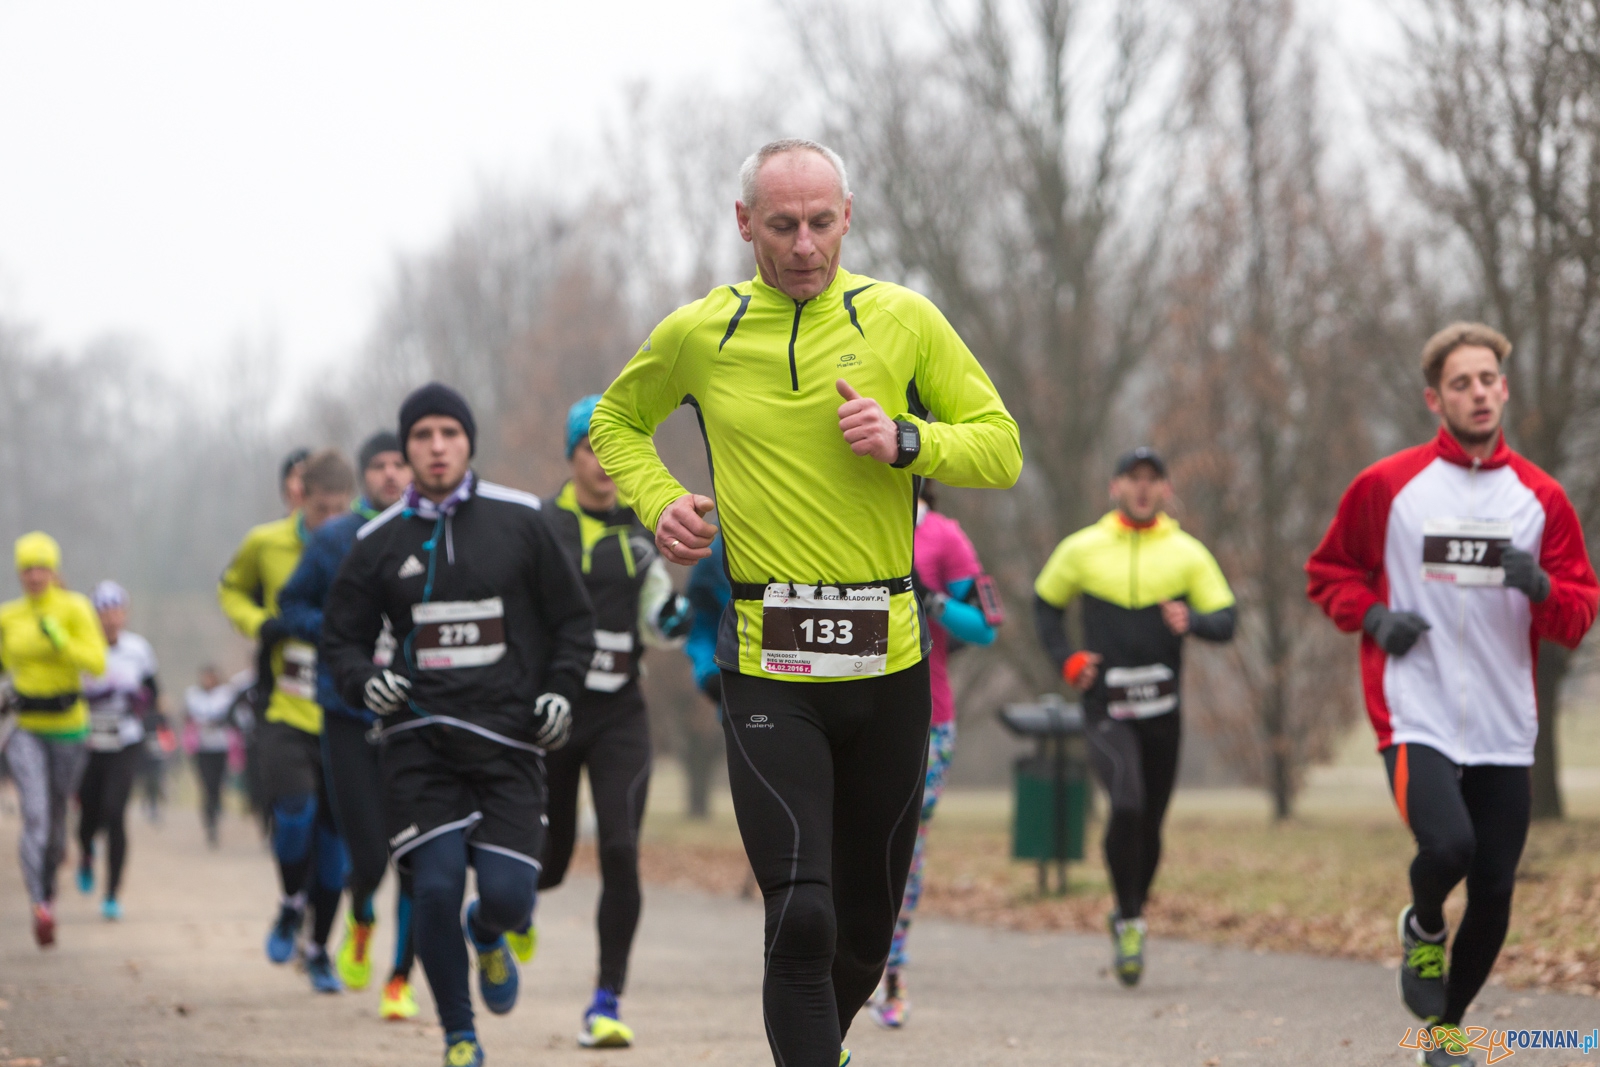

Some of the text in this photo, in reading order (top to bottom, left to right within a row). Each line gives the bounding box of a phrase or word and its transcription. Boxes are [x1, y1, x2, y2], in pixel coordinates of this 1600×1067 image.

[1445, 540, 1488, 563] 337
[438, 622, 481, 646] 279
[799, 618, 853, 644] 133
[767, 664, 804, 672] 14.02.2016
[745, 722, 775, 730] Kalenji
